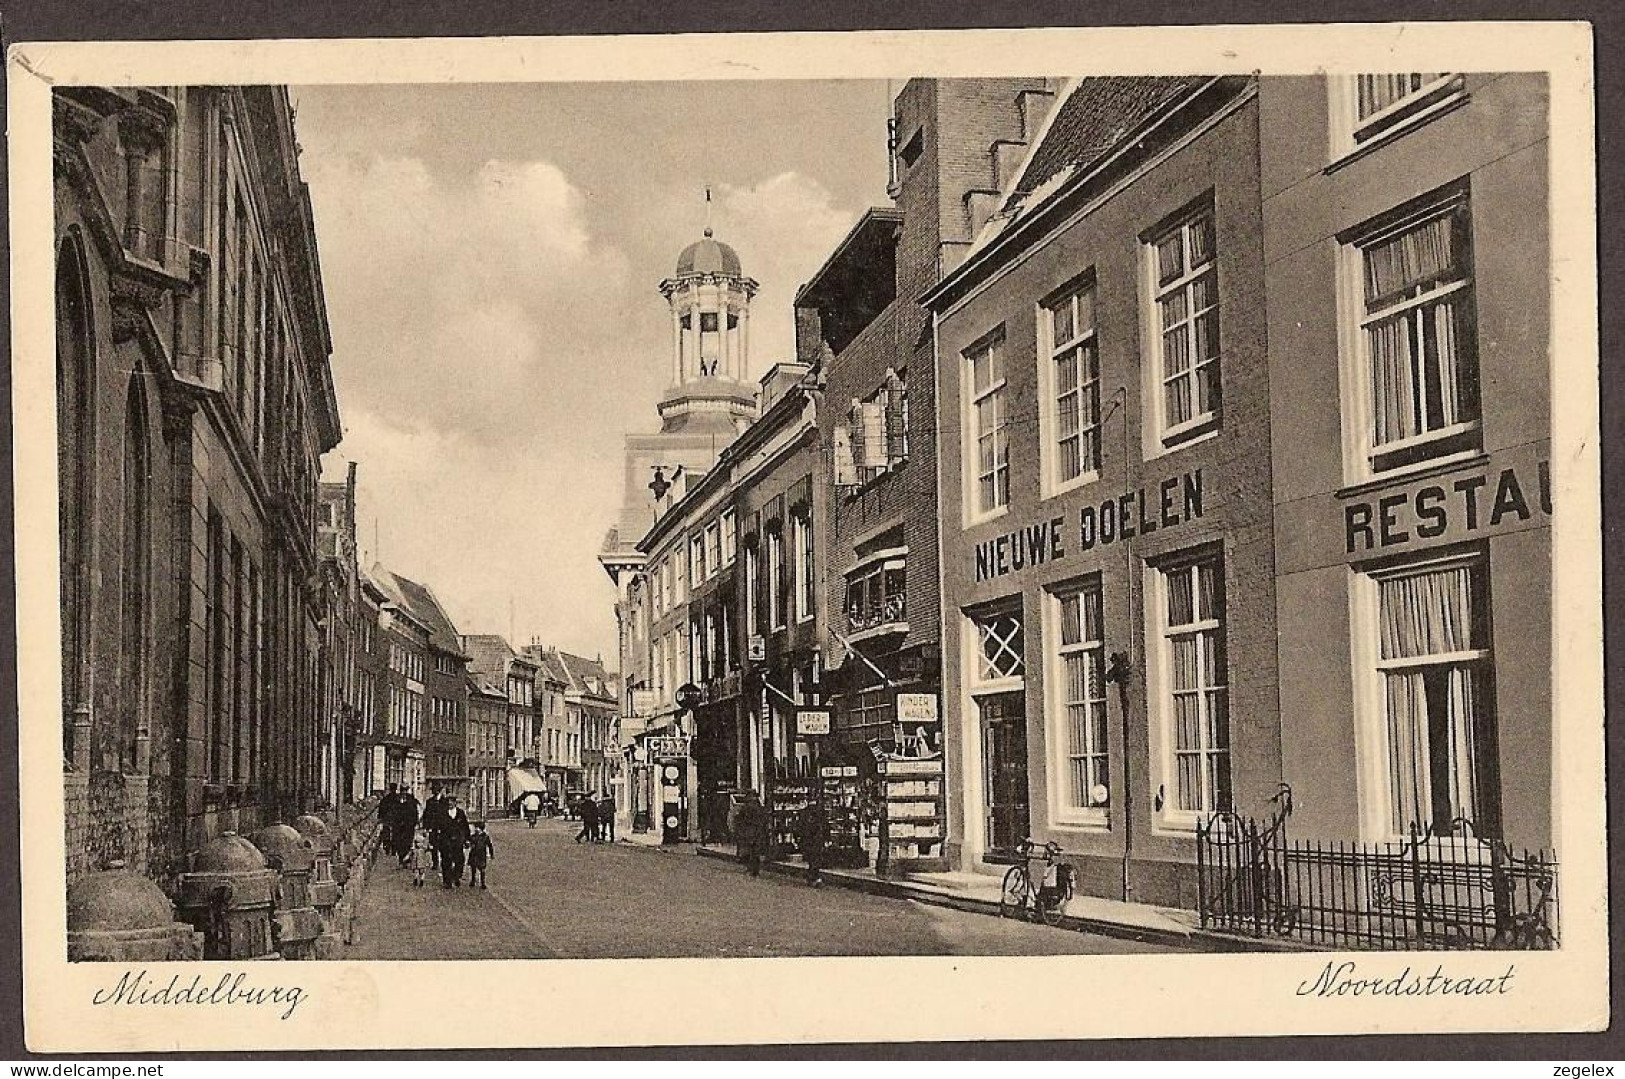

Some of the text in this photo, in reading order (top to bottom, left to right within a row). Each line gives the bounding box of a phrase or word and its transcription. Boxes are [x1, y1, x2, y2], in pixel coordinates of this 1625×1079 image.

[976, 469, 1203, 582] NIEUWE DOELEN
[93, 970, 309, 1020] Middelburg
[1296, 961, 1514, 998] Noordstraat
